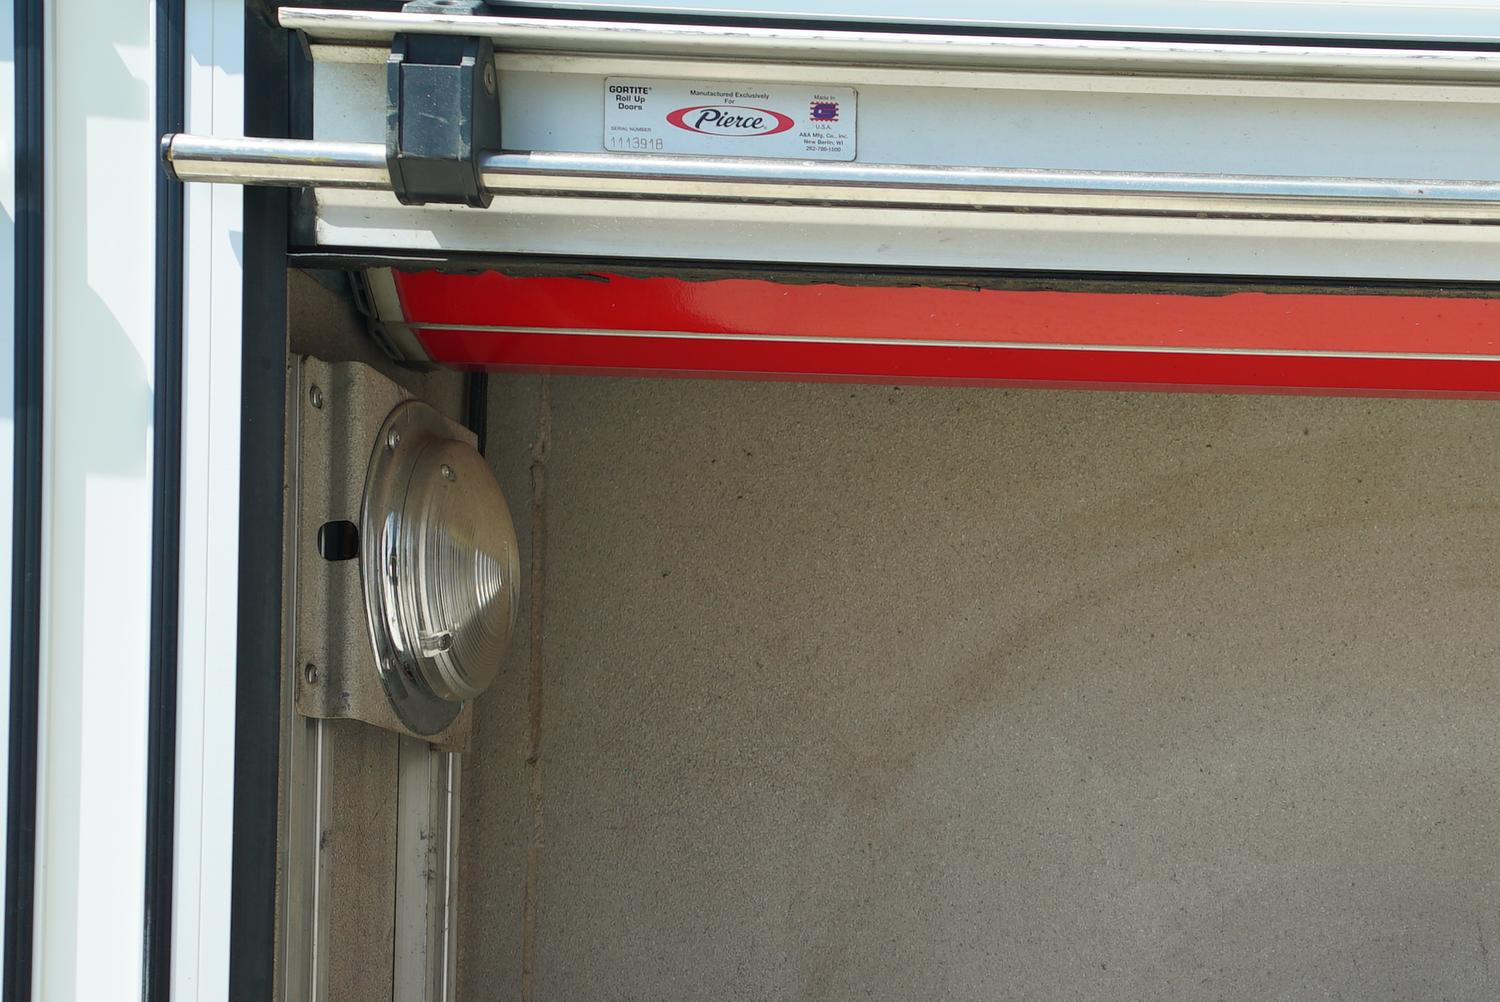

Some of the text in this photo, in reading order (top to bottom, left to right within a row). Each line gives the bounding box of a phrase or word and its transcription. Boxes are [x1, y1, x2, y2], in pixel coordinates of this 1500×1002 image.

[690, 90, 769, 100] Manufactured Exclusively
[695, 108, 764, 129] Pierce
[611, 136, 663, 150] 1113918
